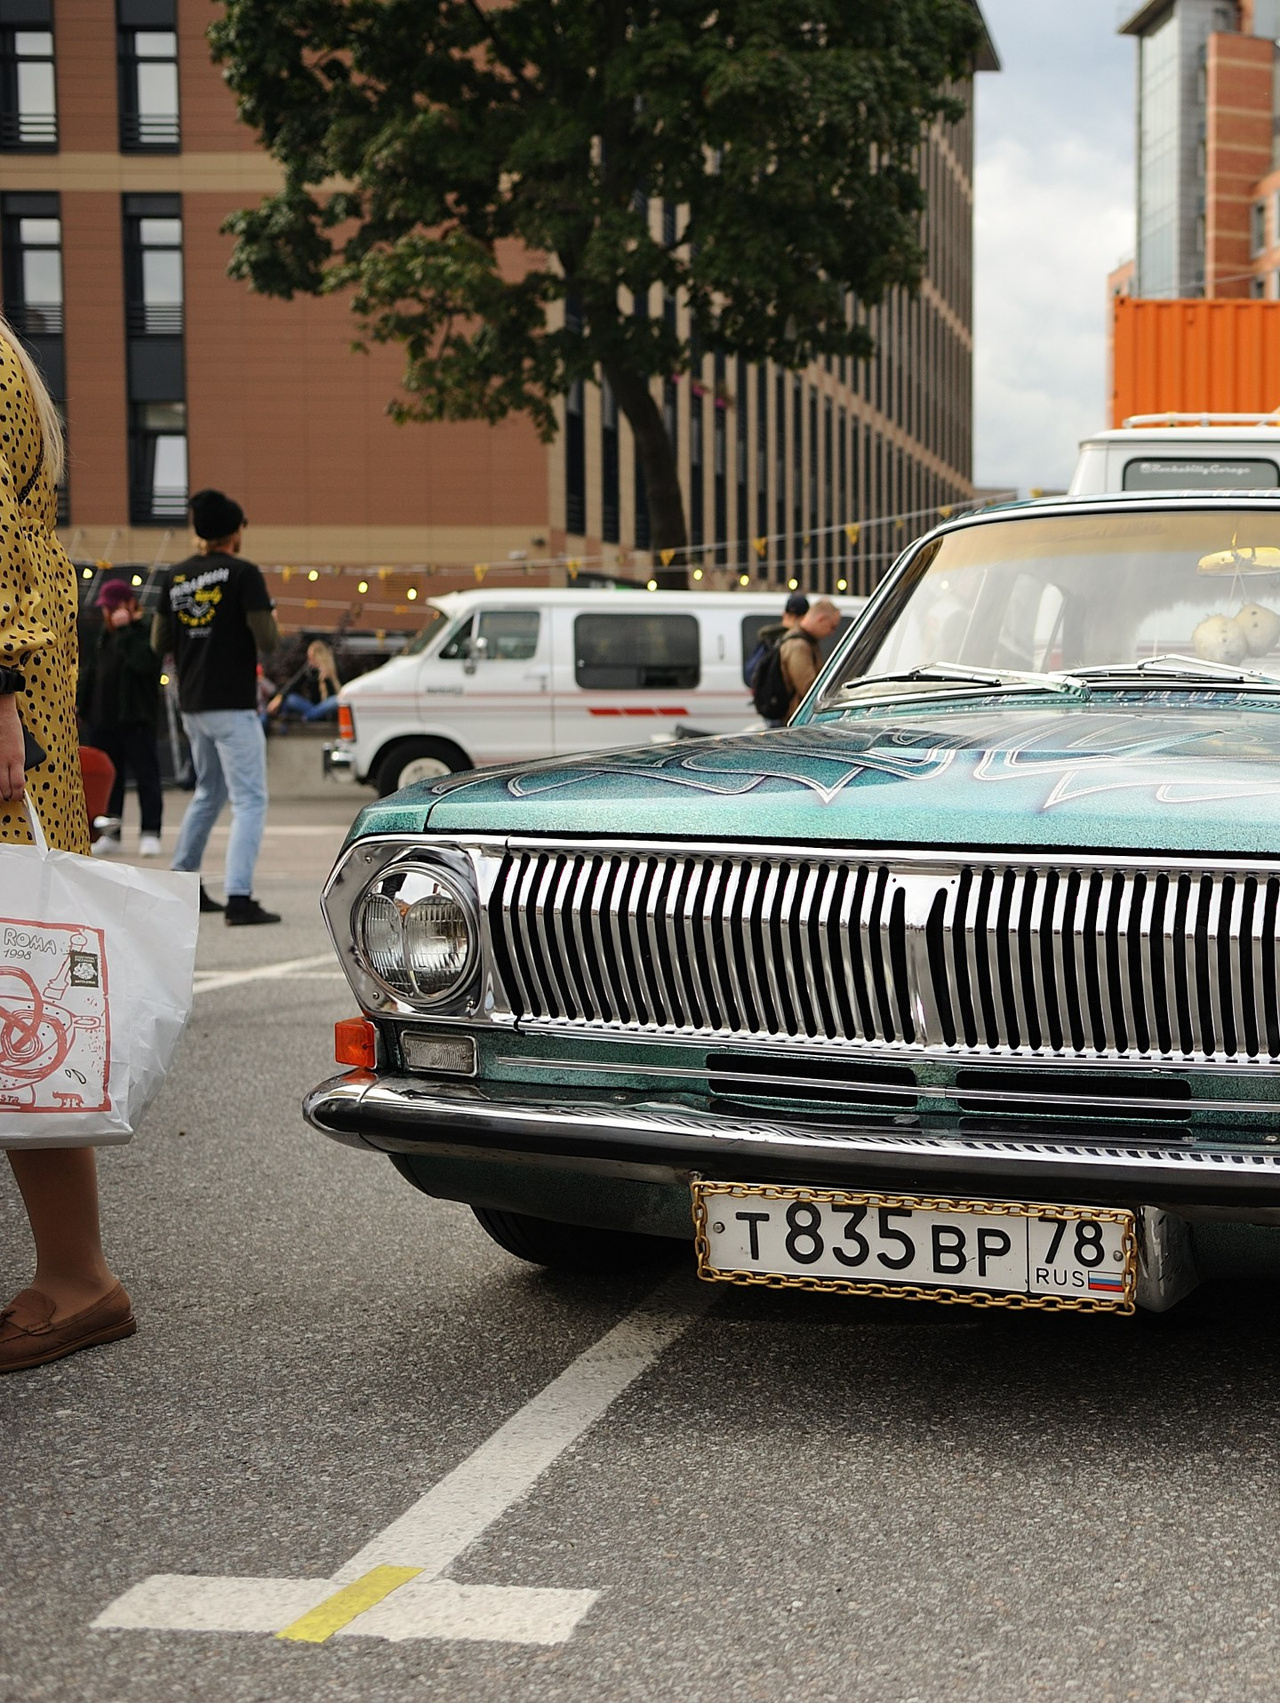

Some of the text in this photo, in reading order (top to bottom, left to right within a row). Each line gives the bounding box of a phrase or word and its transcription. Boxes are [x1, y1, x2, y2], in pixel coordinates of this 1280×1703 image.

[4, 927, 57, 955] ROMA
[3, 949, 32, 960] 1998
[1037, 1216, 1106, 1268] 78
[1035, 1267, 1086, 1289] RUS
